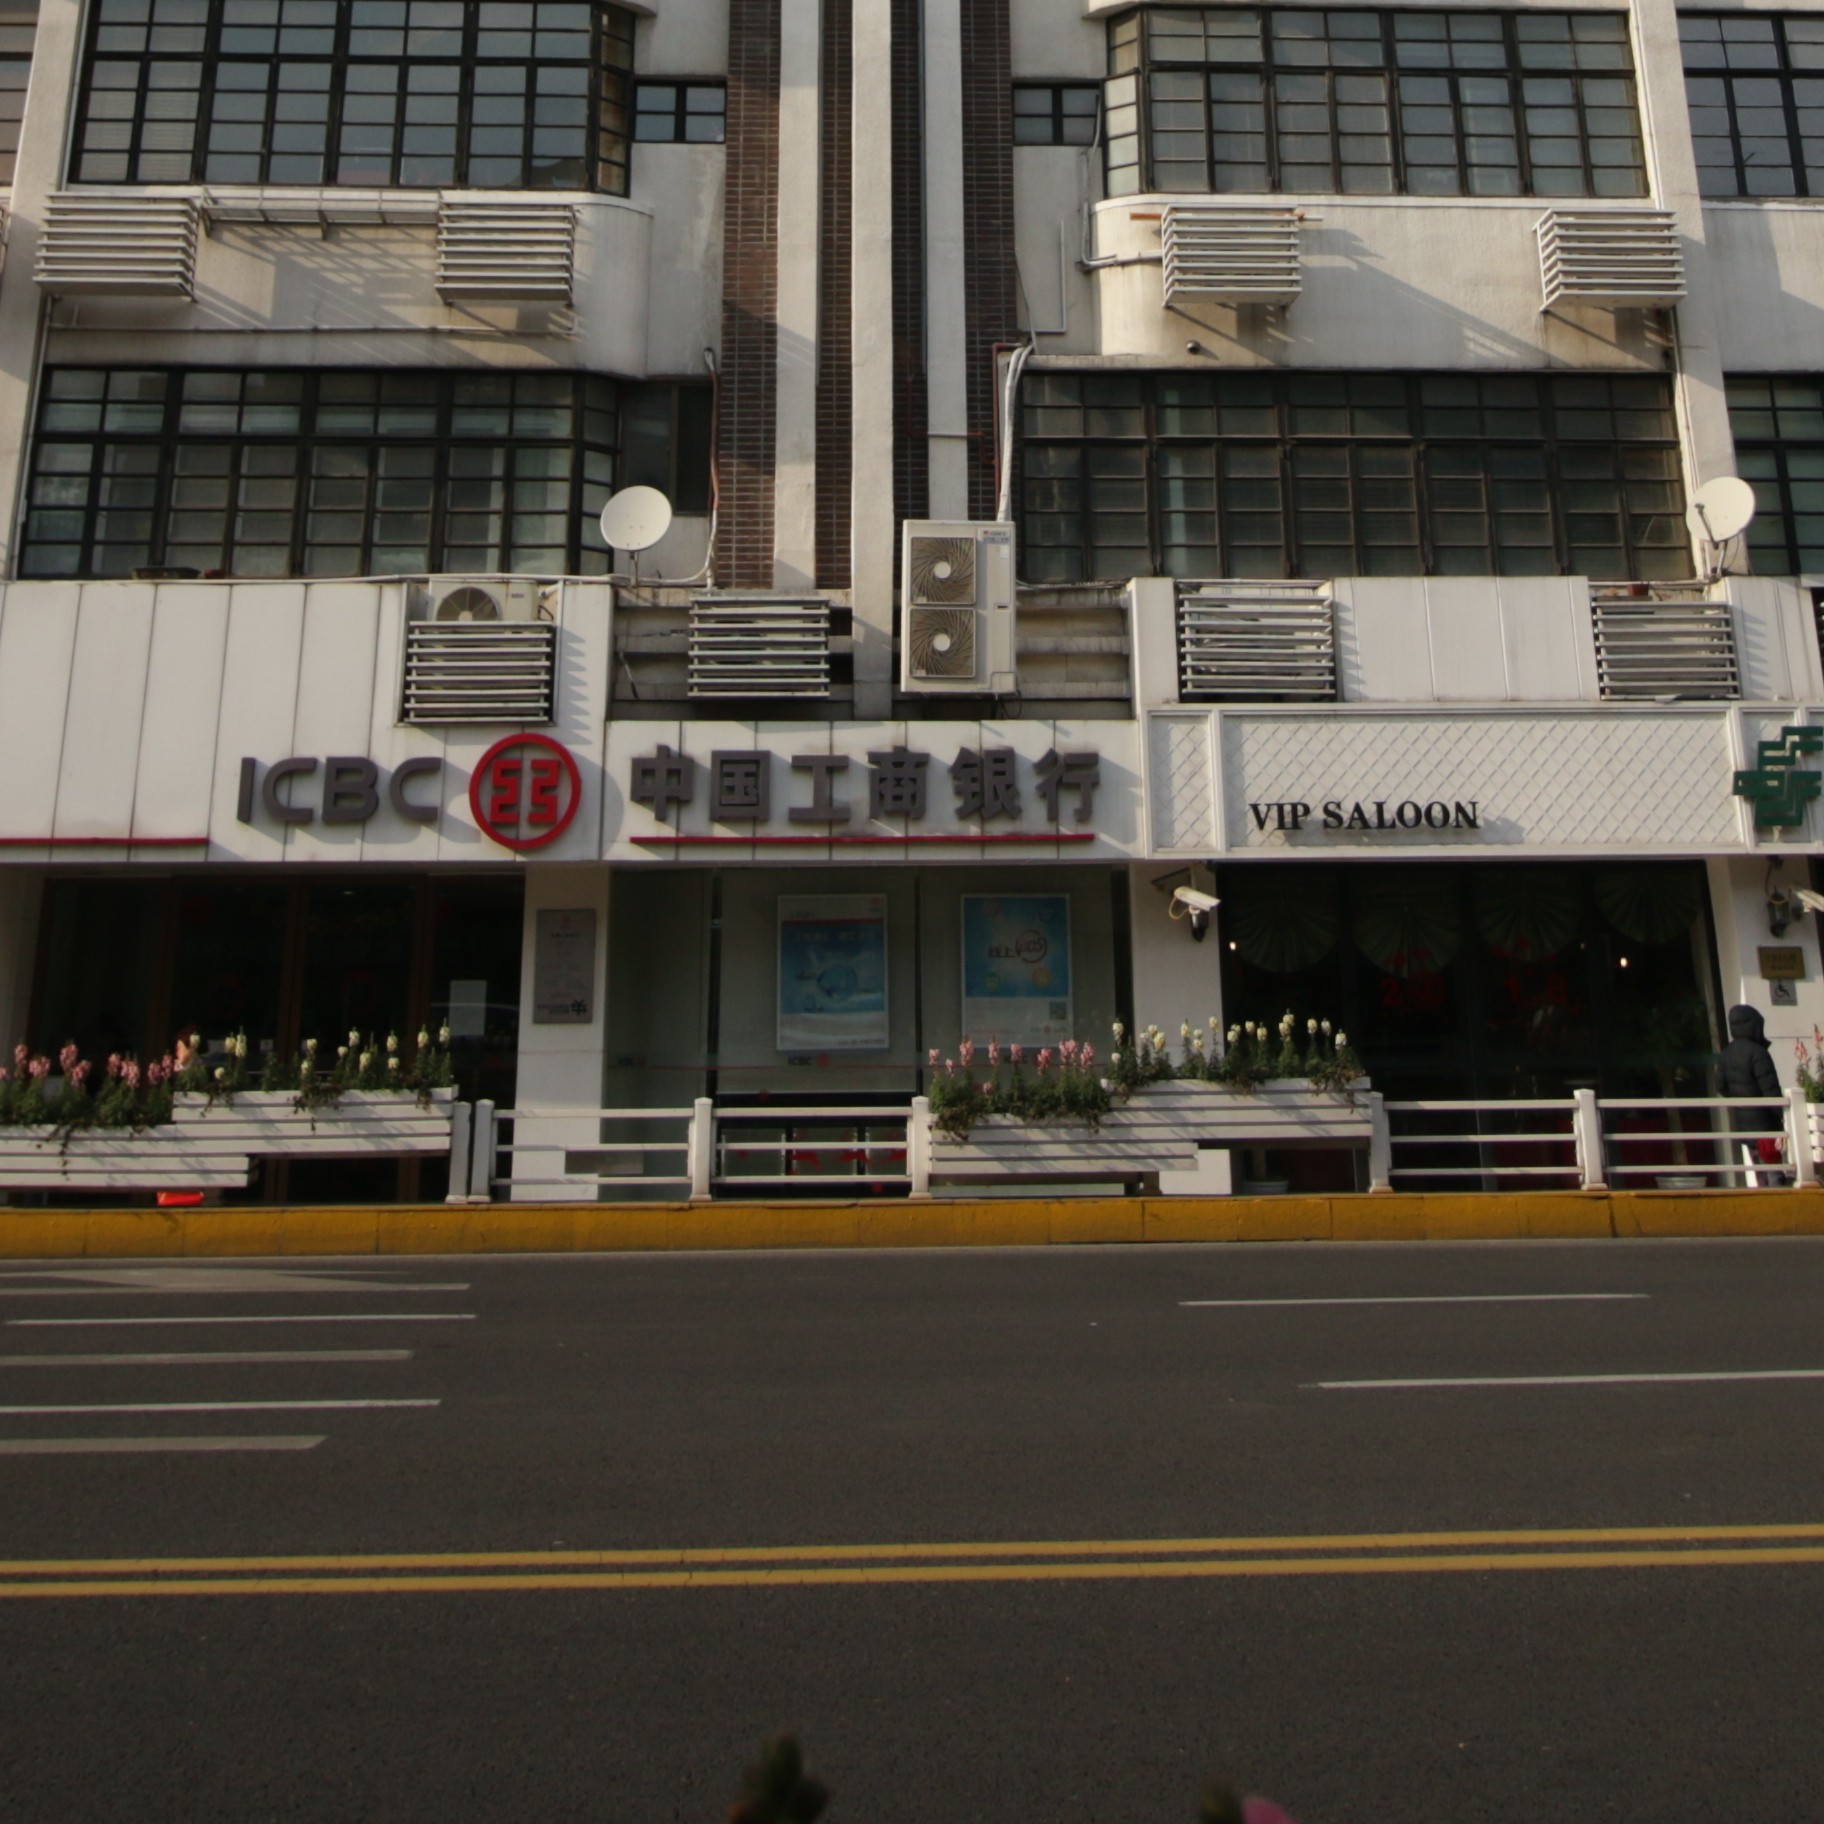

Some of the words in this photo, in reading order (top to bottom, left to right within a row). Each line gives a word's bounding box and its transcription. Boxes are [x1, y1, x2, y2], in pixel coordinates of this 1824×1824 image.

[238, 755, 443, 824] ICBC
[631, 744, 1101, 822] 中国工商银行
[1250, 801, 1312, 833] VIP
[1322, 799, 1479, 831] SALOON
